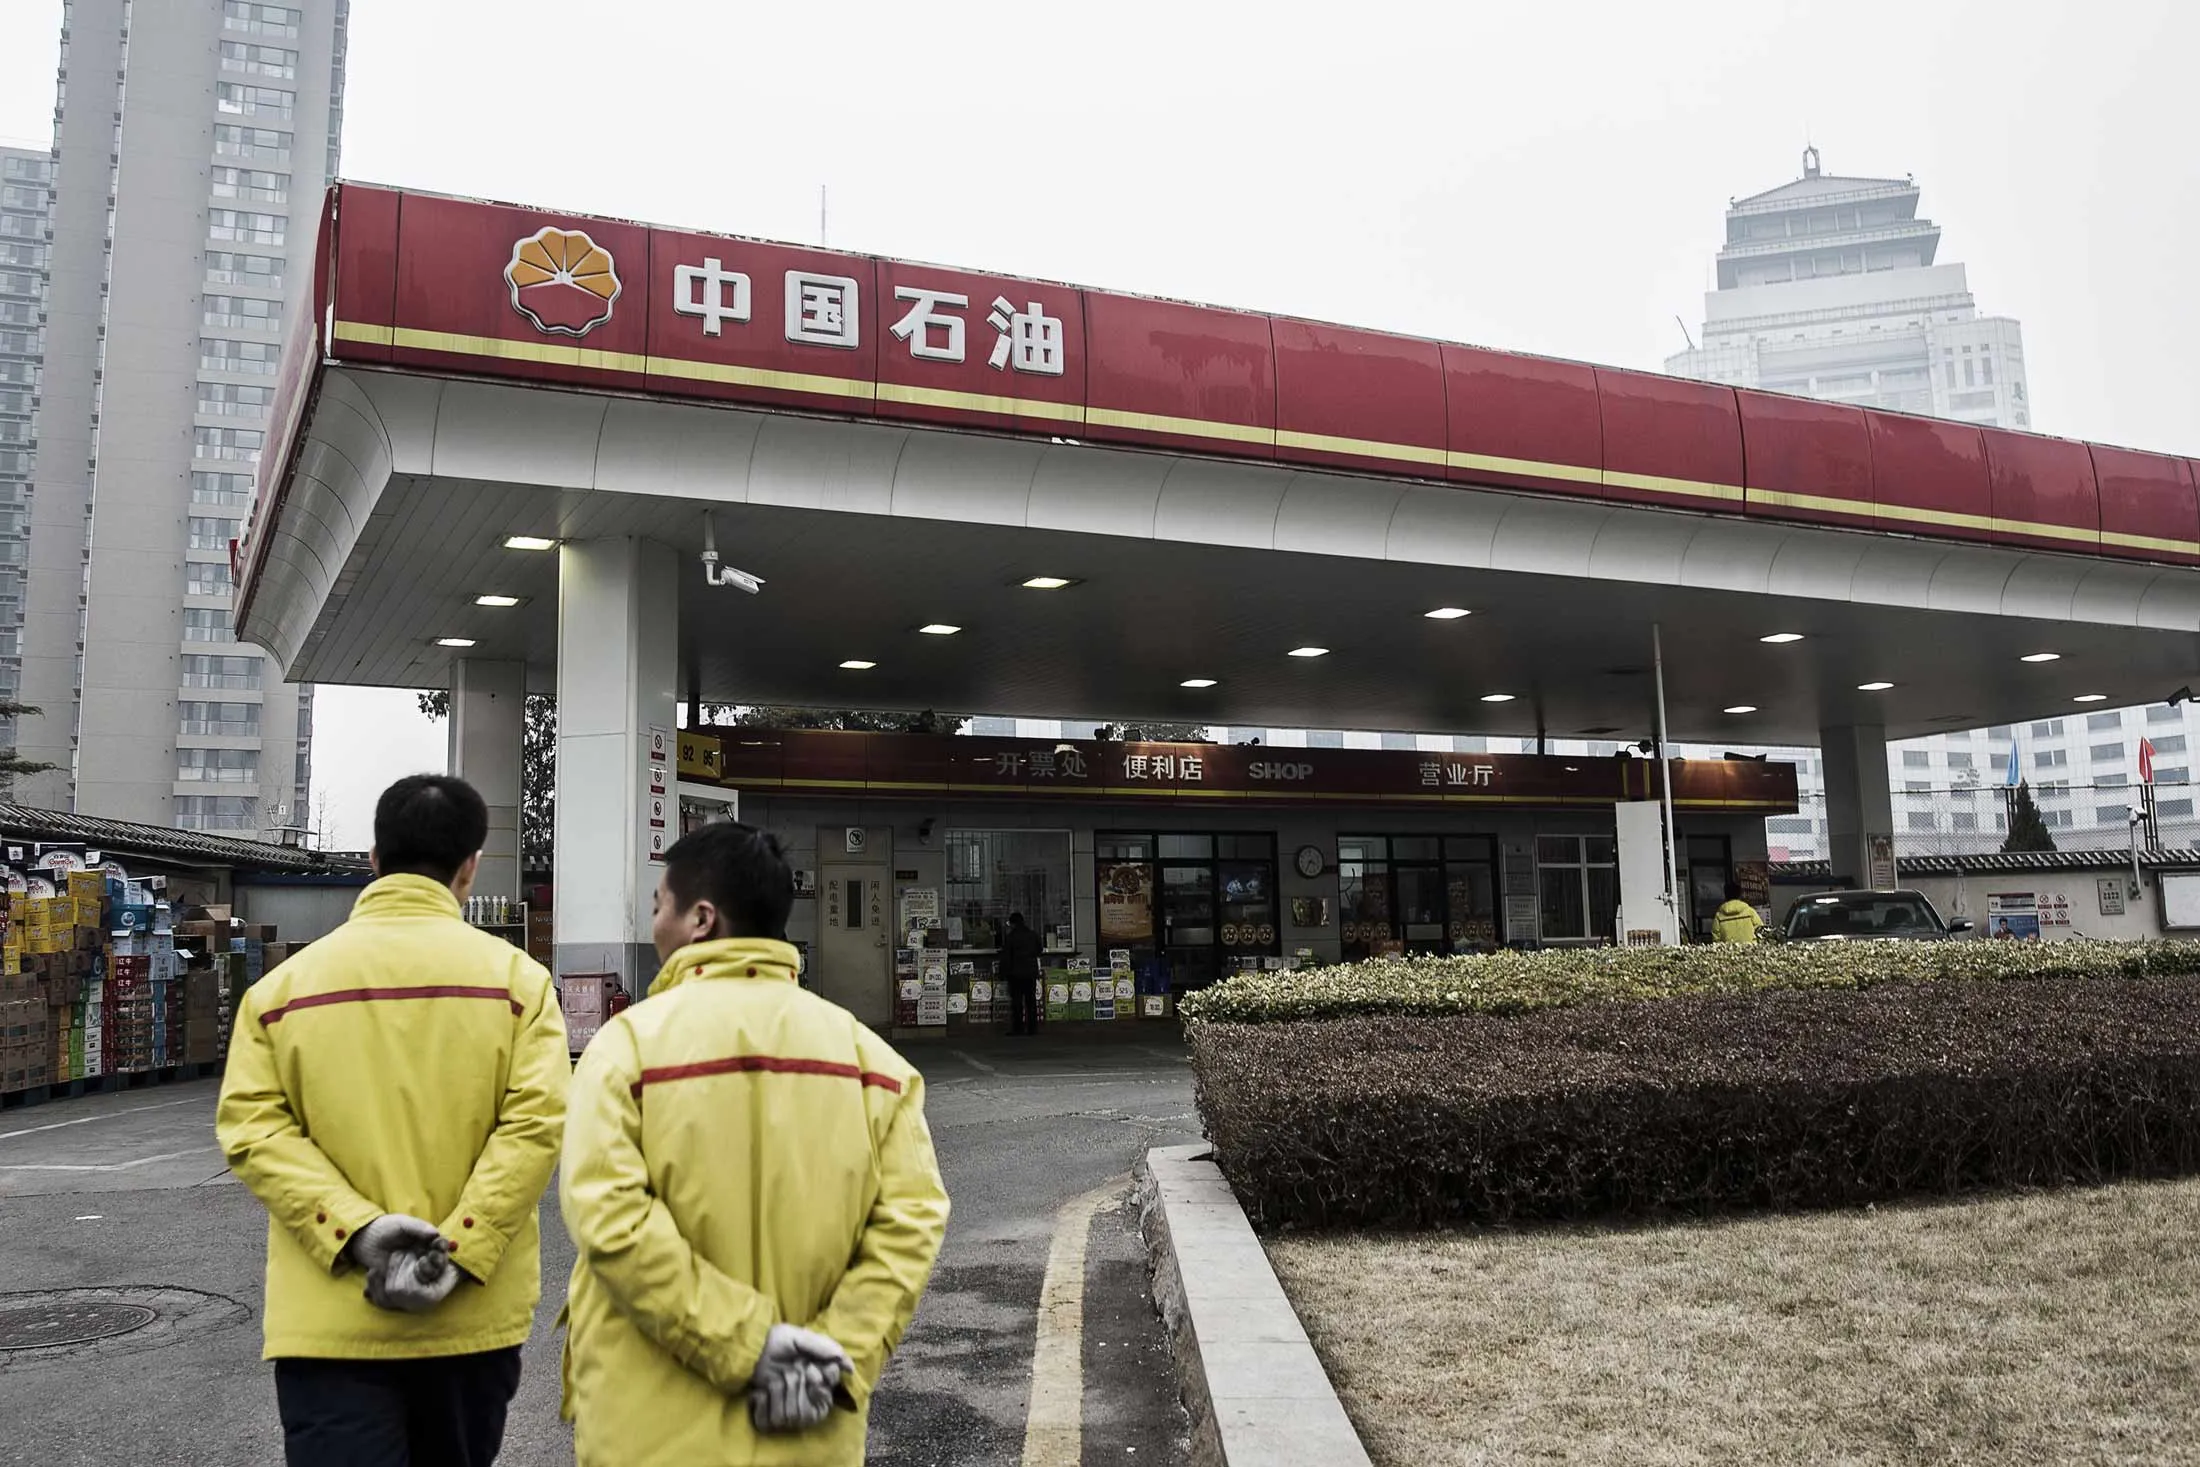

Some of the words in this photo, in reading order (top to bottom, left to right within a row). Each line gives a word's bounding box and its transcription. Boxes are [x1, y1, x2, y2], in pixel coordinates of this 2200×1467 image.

[674, 257, 1065, 376] 中国石油
[683, 745, 694, 762] 92
[703, 750, 714, 767] 95
[996, 750, 1088, 778] 开票处
[1123, 754, 1203, 781] 便利店
[1249, 762, 1314, 781] SHOP
[1419, 762, 1494, 786] 营业厅
[828, 880, 839, 927] 配电重地
[870, 880, 880, 926] 闲人免进
[117, 968, 131, 976] 红牛
[118, 957, 132, 966] 红牛
[118, 979, 132, 987] 红牛
